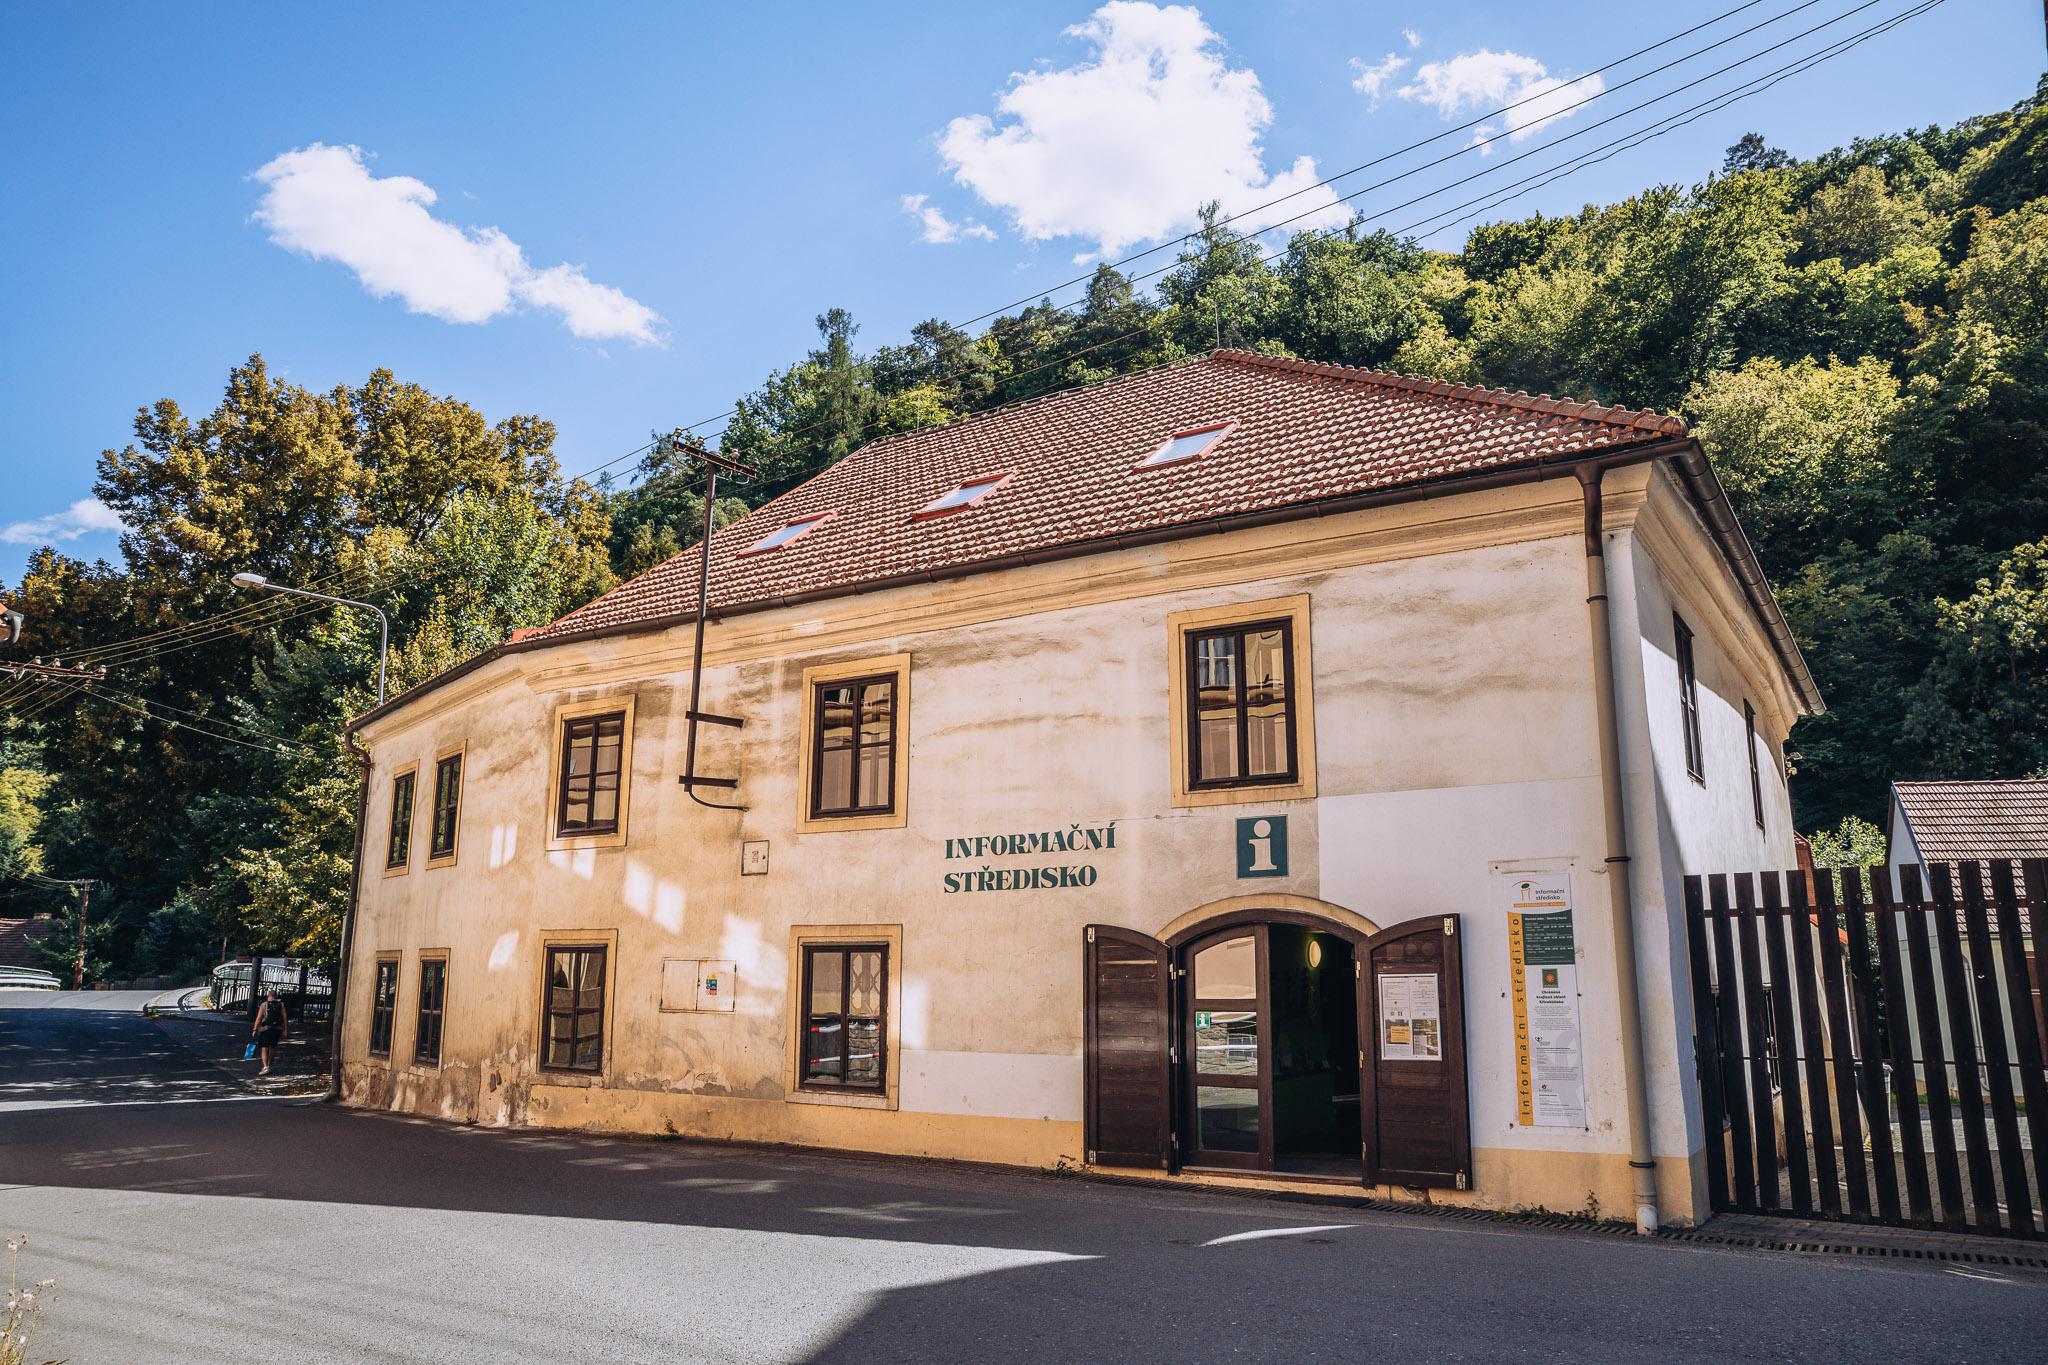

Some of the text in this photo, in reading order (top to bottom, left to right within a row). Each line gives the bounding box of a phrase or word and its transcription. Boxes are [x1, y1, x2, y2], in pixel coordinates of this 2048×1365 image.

[944, 822, 1117, 860] INFORMAČNÍ
[943, 864, 1098, 894] STŘEDISKO
[1512, 918, 1530, 1115] Informační středisko
